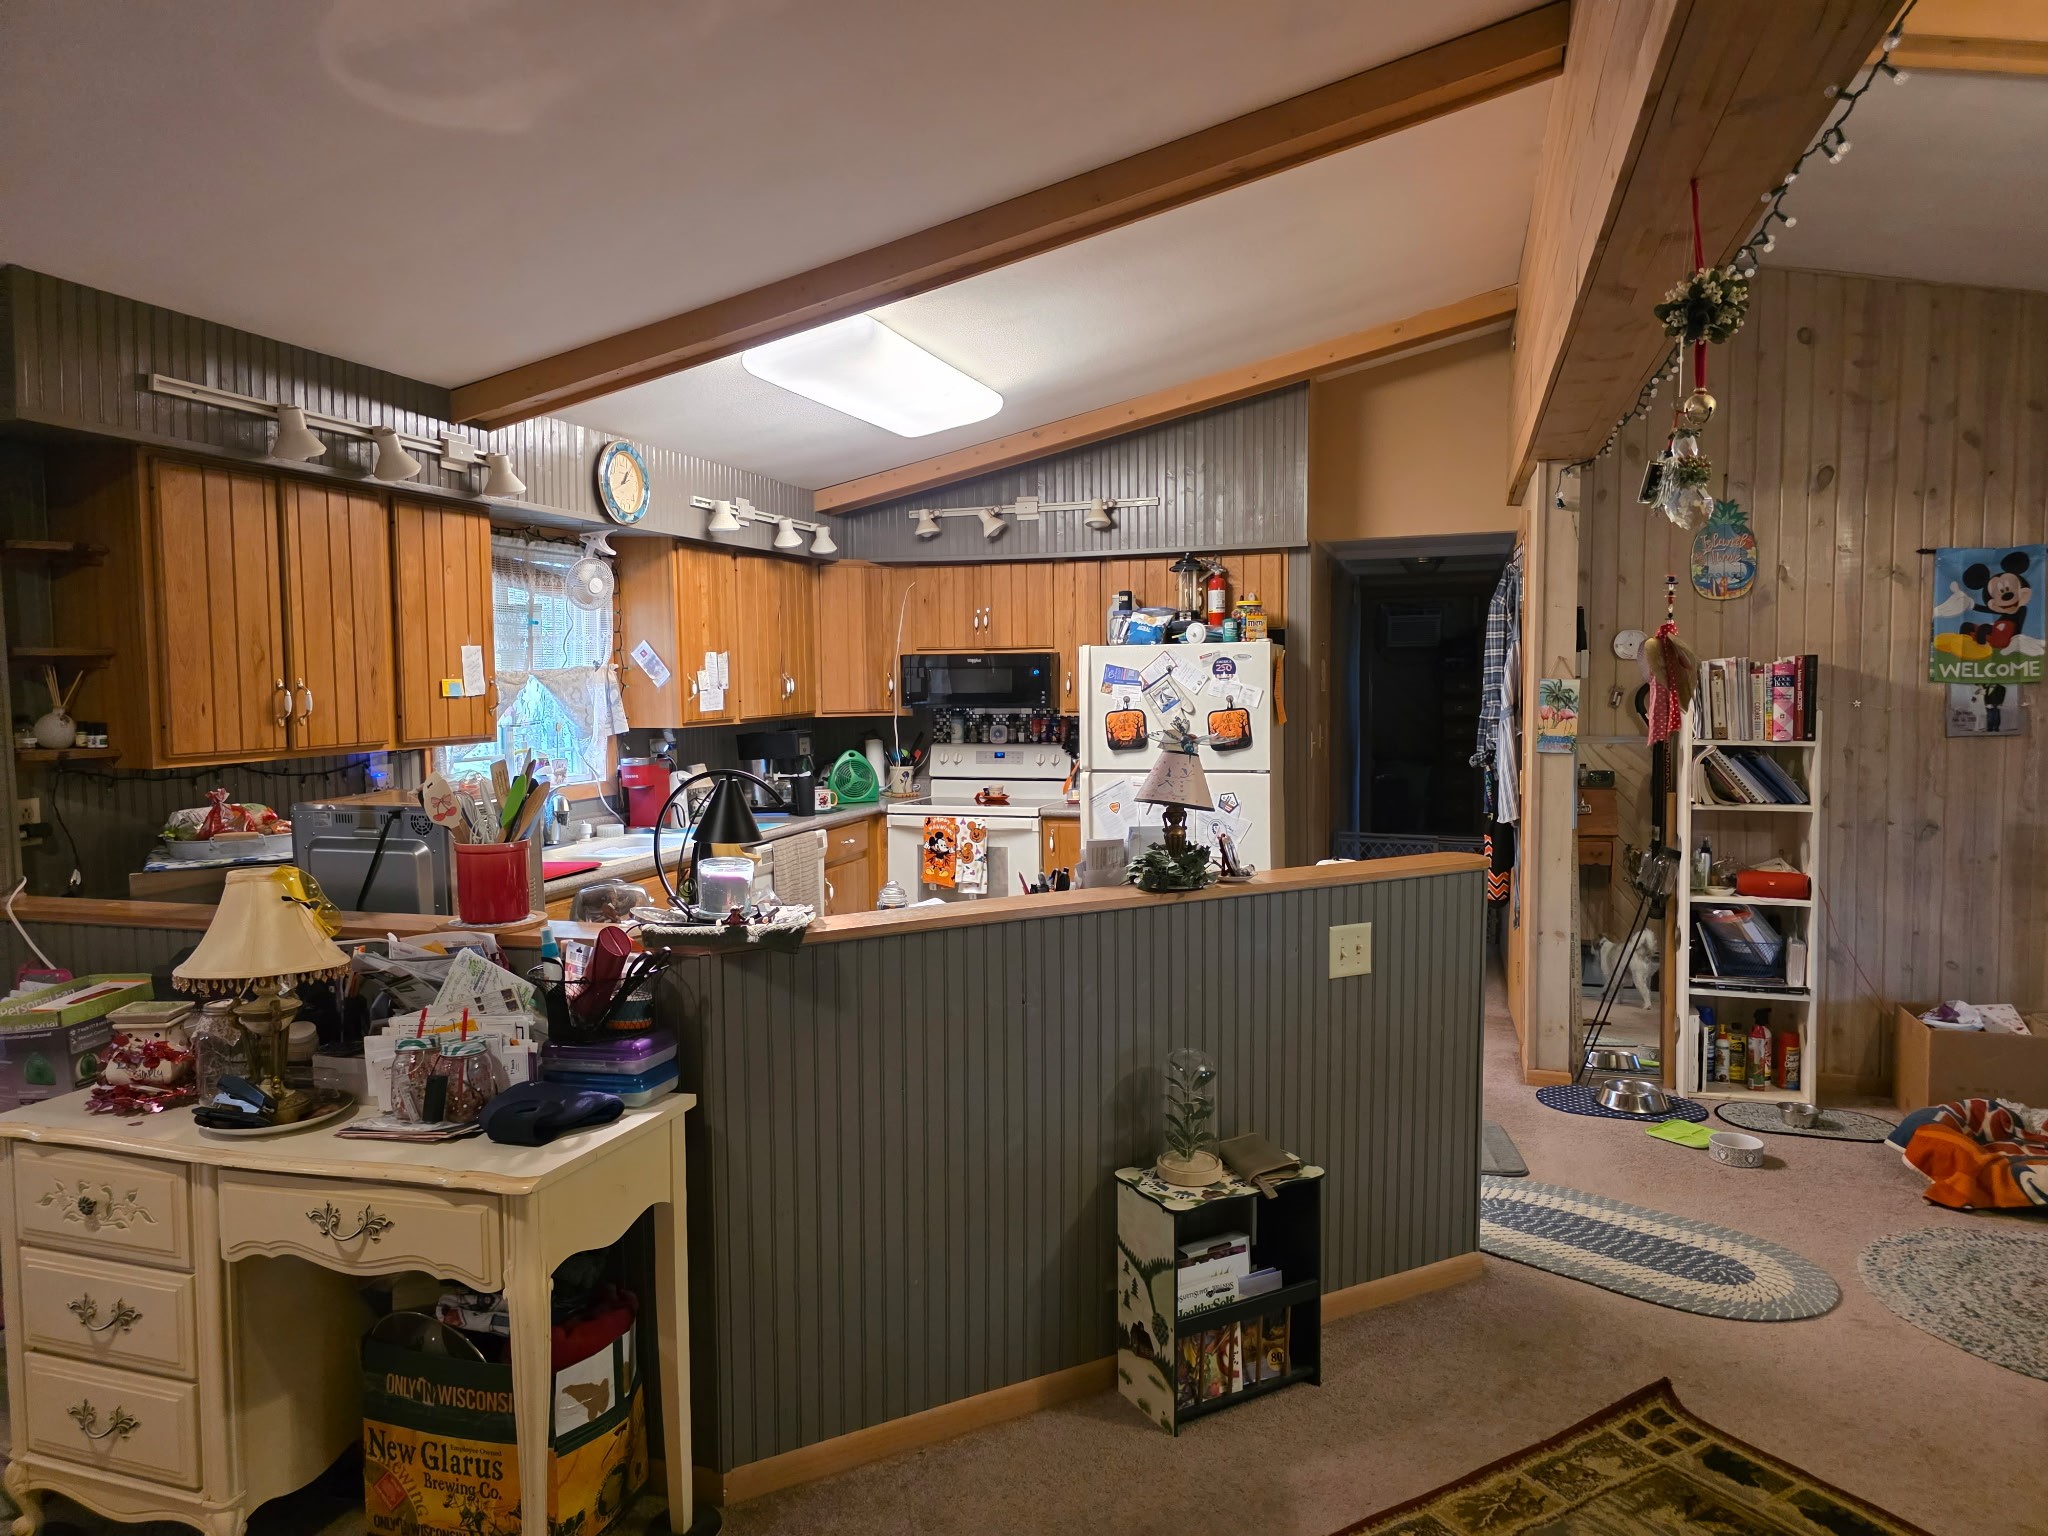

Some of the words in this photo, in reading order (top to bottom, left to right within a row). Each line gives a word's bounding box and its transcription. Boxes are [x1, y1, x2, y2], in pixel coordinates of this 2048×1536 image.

[1939, 661, 2041, 678] WELCOME
[0, 994, 53, 1017] Personal
[386, 1373, 417, 1399] ONLY
[436, 1384, 515, 1413] WISCONSI
[368, 1426, 417, 1465] New
[421, 1441, 503, 1481] Glarus
[424, 1472, 476, 1497] Brewing
[479, 1482, 502, 1501] Co.
[373, 1514, 398, 1529] ONLY
